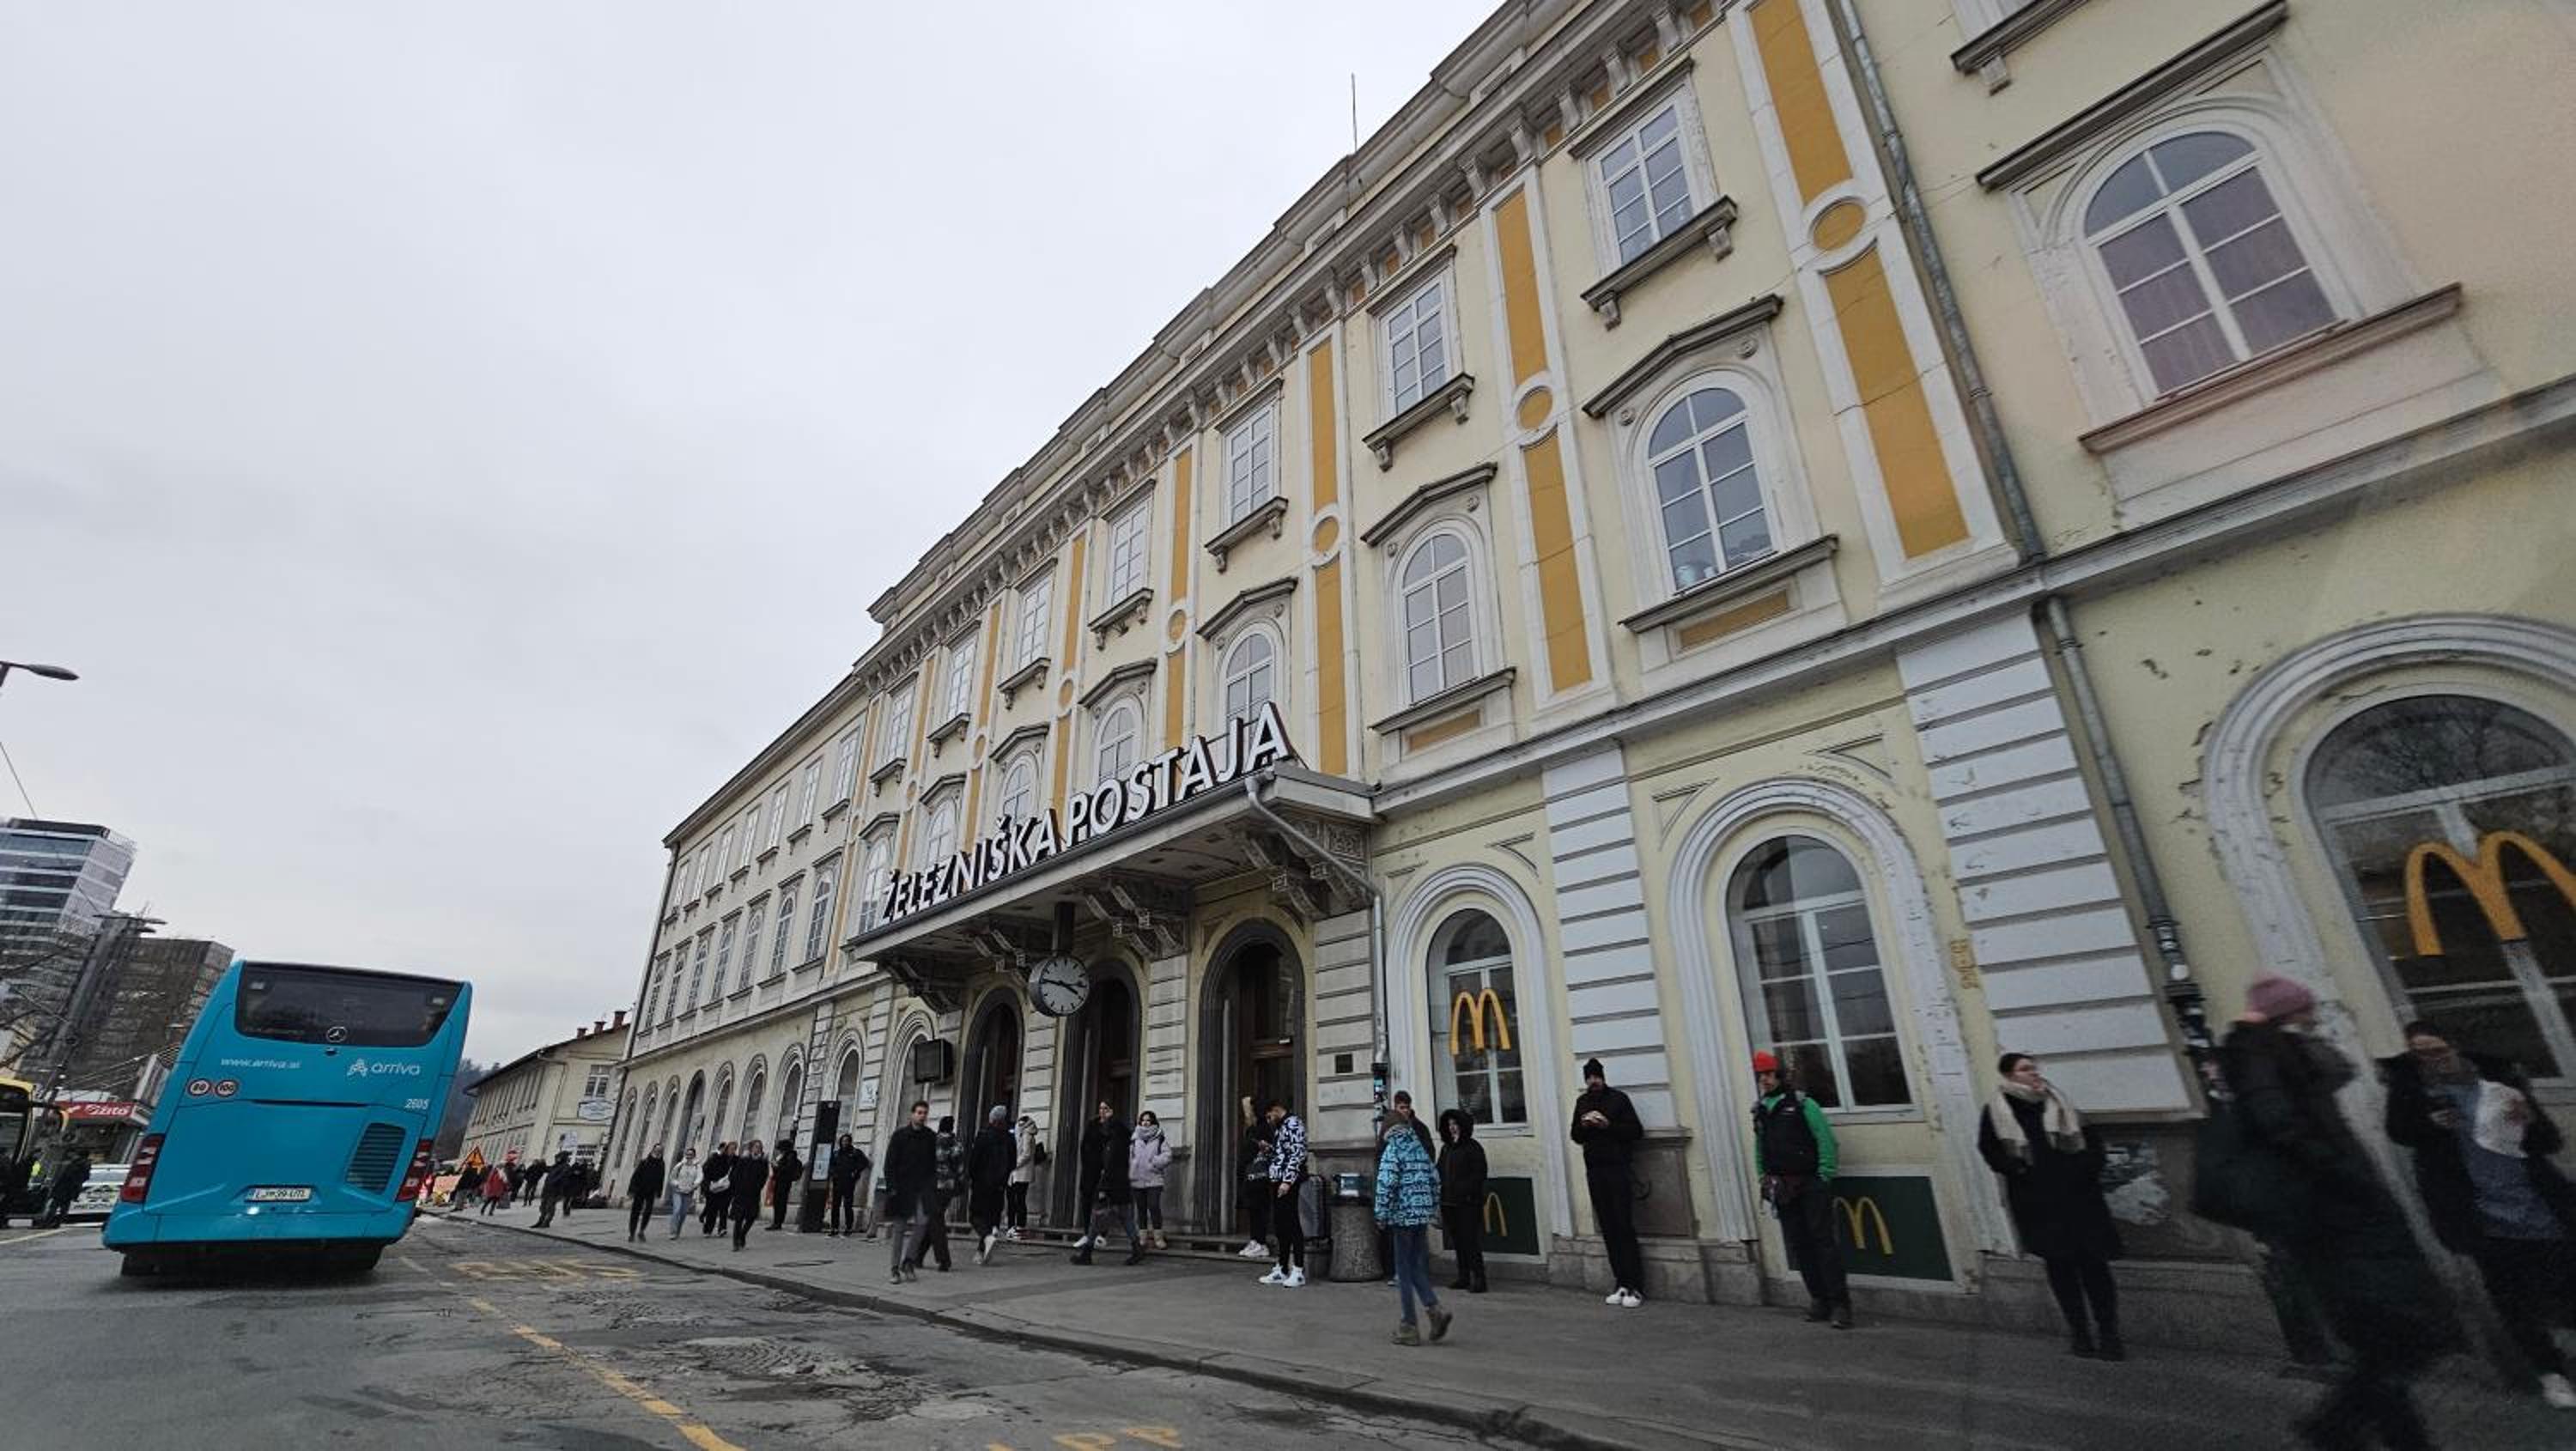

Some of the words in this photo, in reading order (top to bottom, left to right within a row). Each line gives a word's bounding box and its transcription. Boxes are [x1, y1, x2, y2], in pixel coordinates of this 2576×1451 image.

[882, 807, 1062, 925] ŽELEZNIŠKA
[1066, 700, 1291, 847] POSTAJA
[370, 1061, 421, 1076] arriva
